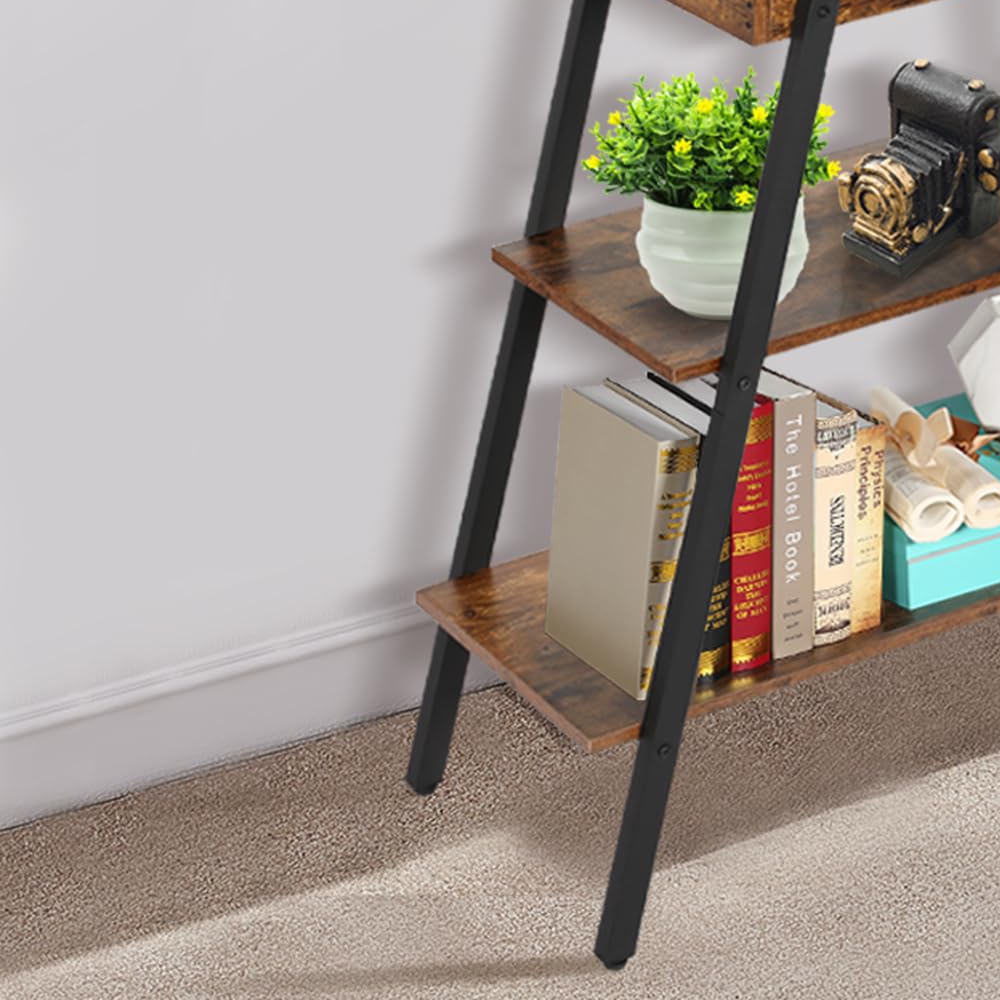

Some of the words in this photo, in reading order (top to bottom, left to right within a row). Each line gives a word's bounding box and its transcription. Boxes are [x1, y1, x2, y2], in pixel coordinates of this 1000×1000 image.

[785, 414, 802, 455] The
[785, 464, 801, 522] Hotel
[871, 449, 885, 508] Physics
[784, 531, 802, 584] Book
